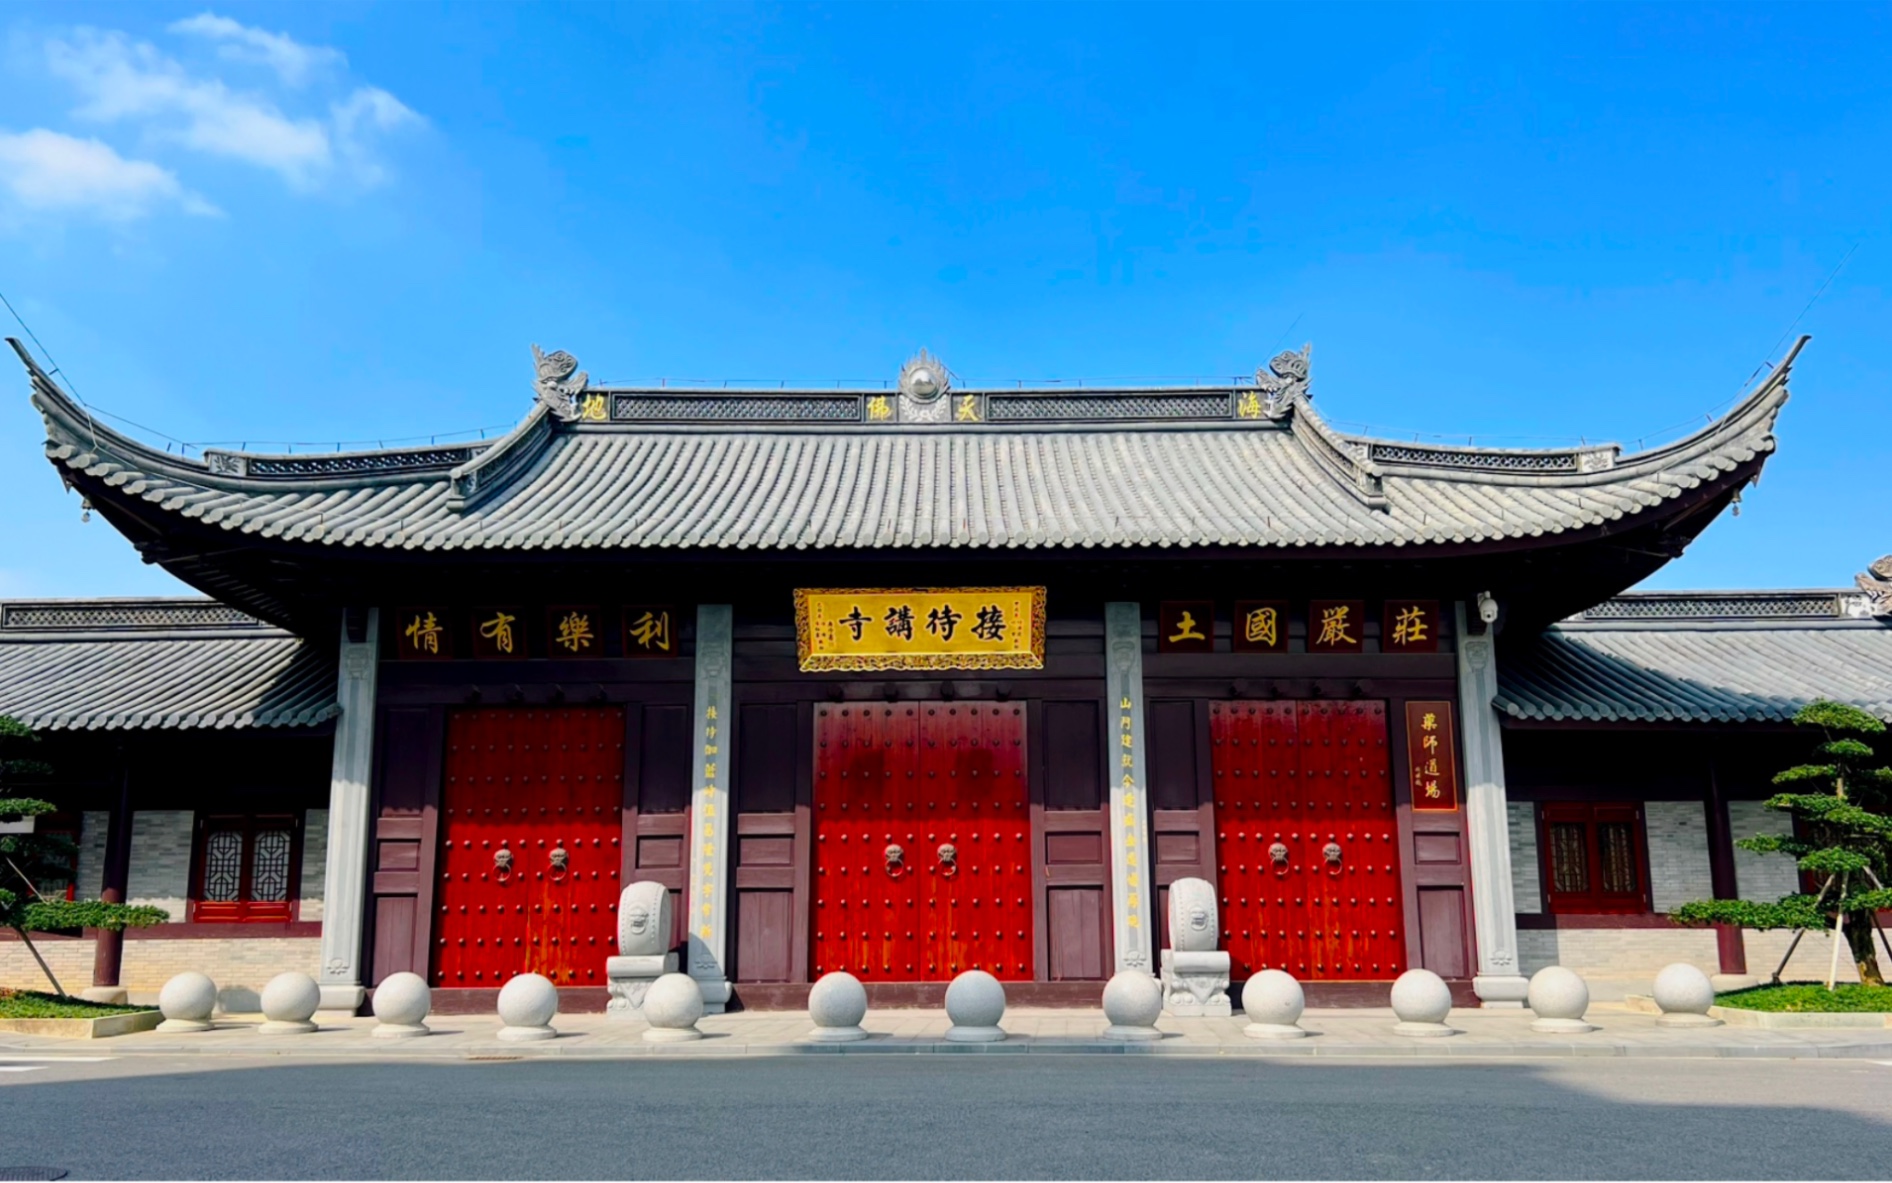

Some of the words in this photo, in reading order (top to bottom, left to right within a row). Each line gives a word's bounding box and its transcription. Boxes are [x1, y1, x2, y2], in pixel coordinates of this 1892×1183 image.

[404, 611, 671, 655] 利樂有情
[838, 603, 1007, 642] 接待講寺
[1168, 605, 1430, 647] 莊嚴國土
